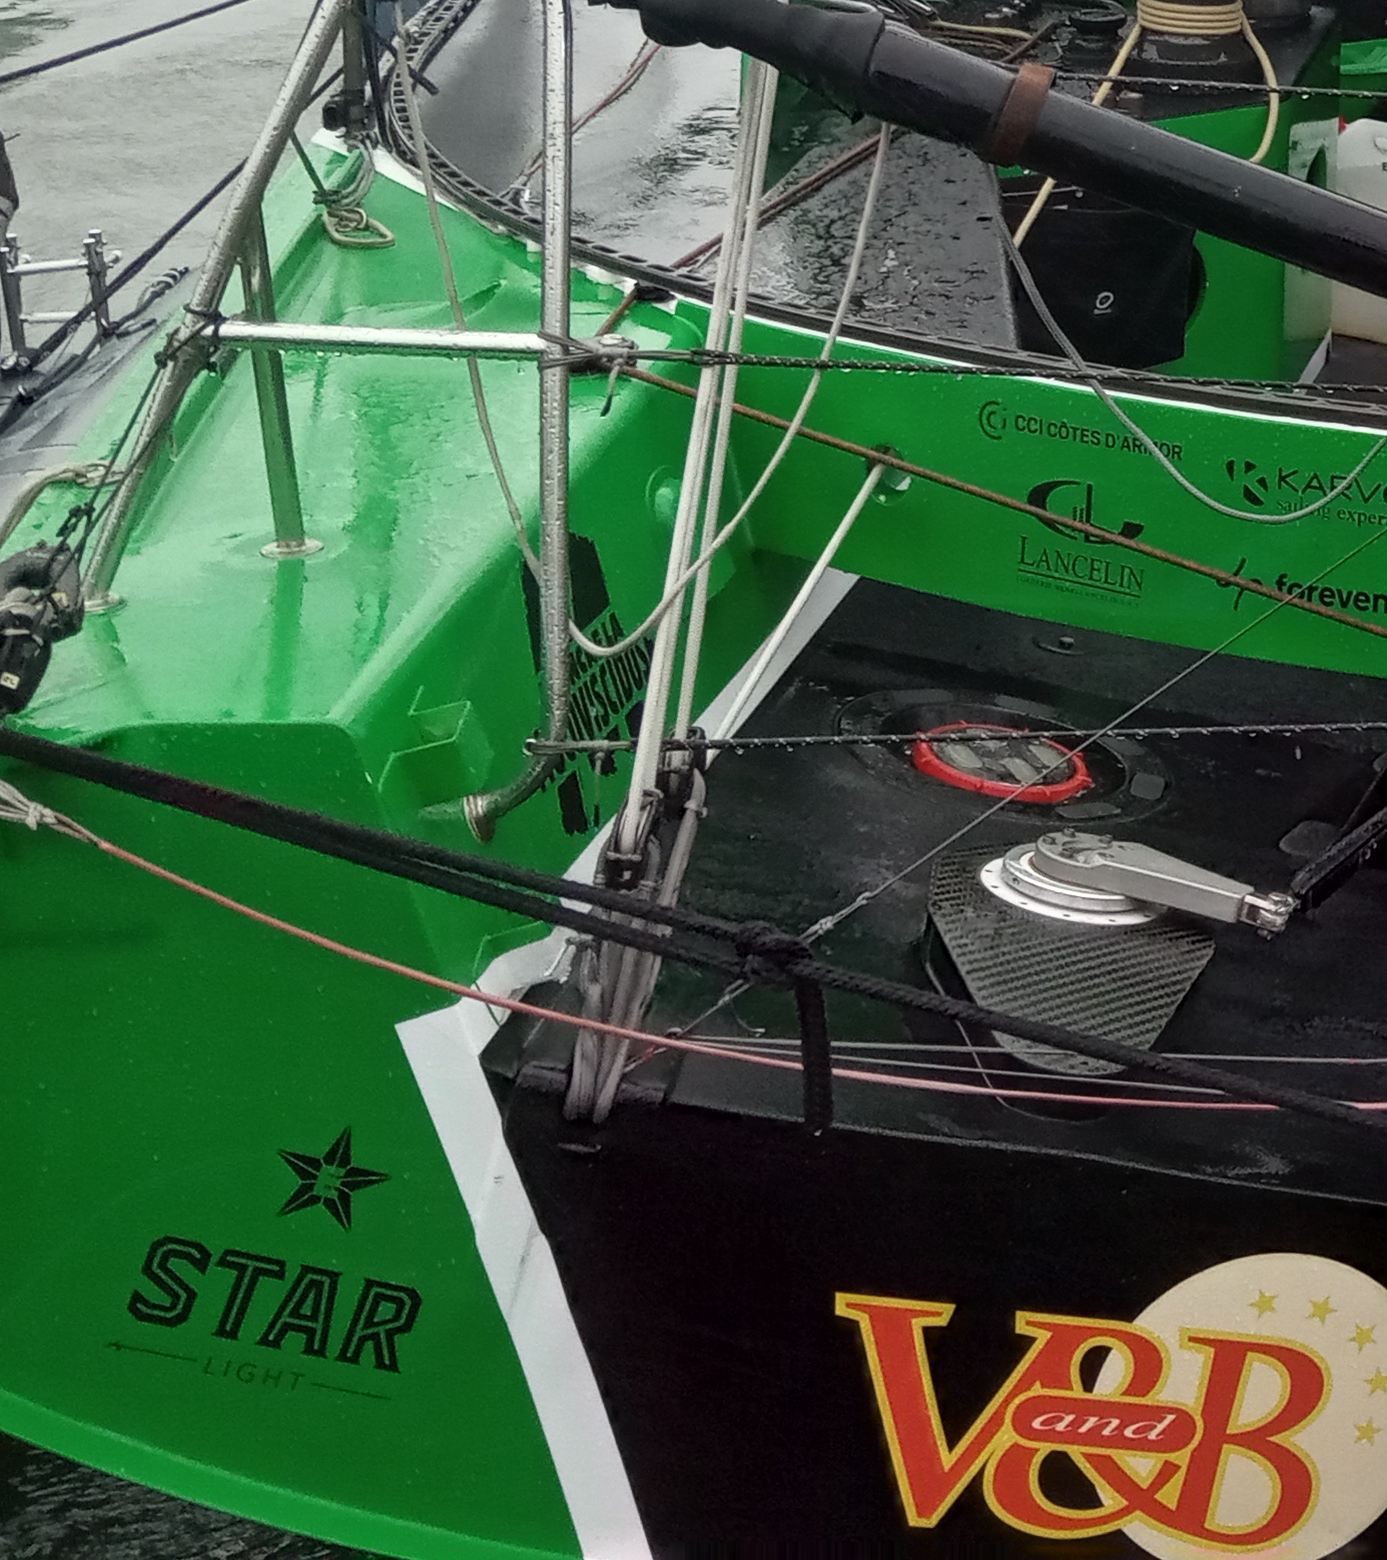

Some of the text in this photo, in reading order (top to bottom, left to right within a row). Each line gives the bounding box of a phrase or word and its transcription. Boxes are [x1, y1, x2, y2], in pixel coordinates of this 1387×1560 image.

[1014, 414, 1044, 436] CCI
[1047, 421, 1101, 447] CÔTES
[1017, 535, 1146, 592] LANCELIN
[127, 1235, 423, 1374] STAR
[203, 1355, 306, 1392] LIGHT
[833, 1290, 1334, 1555] V&B
[1028, 1410, 1180, 1442] and
